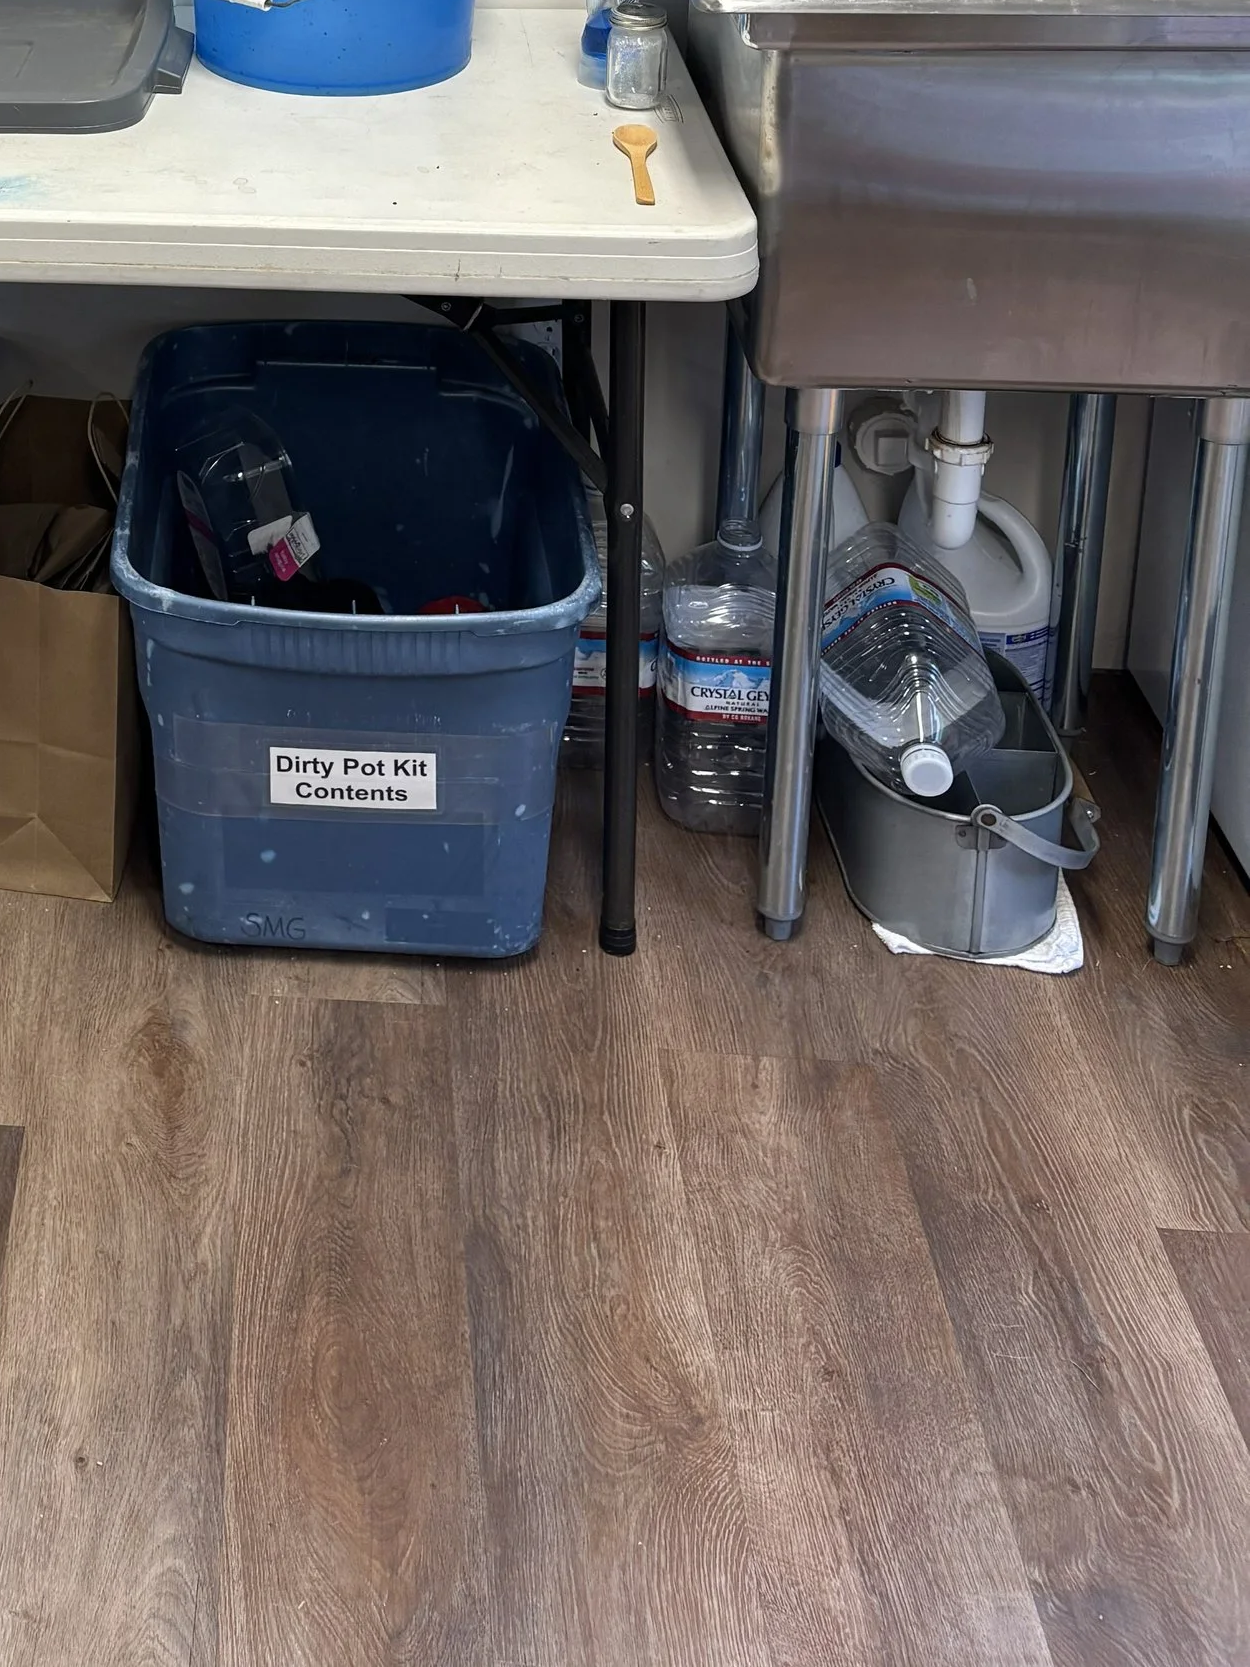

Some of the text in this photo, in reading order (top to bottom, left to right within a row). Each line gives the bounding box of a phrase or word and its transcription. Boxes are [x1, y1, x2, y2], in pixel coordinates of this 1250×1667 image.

[851, 577, 896, 606] CRYSTAL
[691, 686, 769, 701] CRYSTAL GEY
[276, 755, 427, 779] Dirty Pot Kit
[295, 782, 408, 802] Contents
[240, 912, 306, 940] SMG
